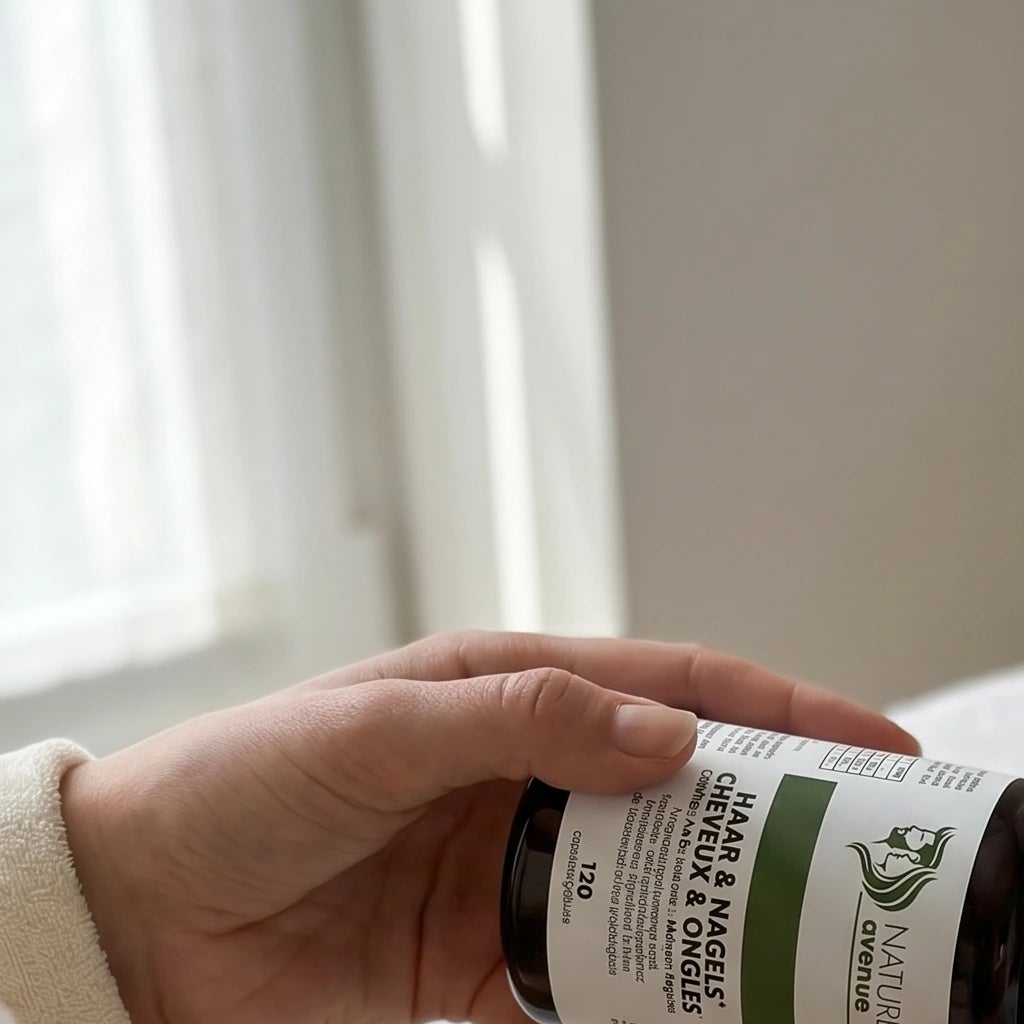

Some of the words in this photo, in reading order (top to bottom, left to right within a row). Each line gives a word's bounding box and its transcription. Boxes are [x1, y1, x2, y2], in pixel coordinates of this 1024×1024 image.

[689, 772, 737, 883] CHEVEUX
[718, 791, 757, 863] HAAR
[576, 861, 597, 900] 120
[685, 889, 707, 907] &
[713, 870, 736, 887] &
[854, 919, 877, 1013] avenue
